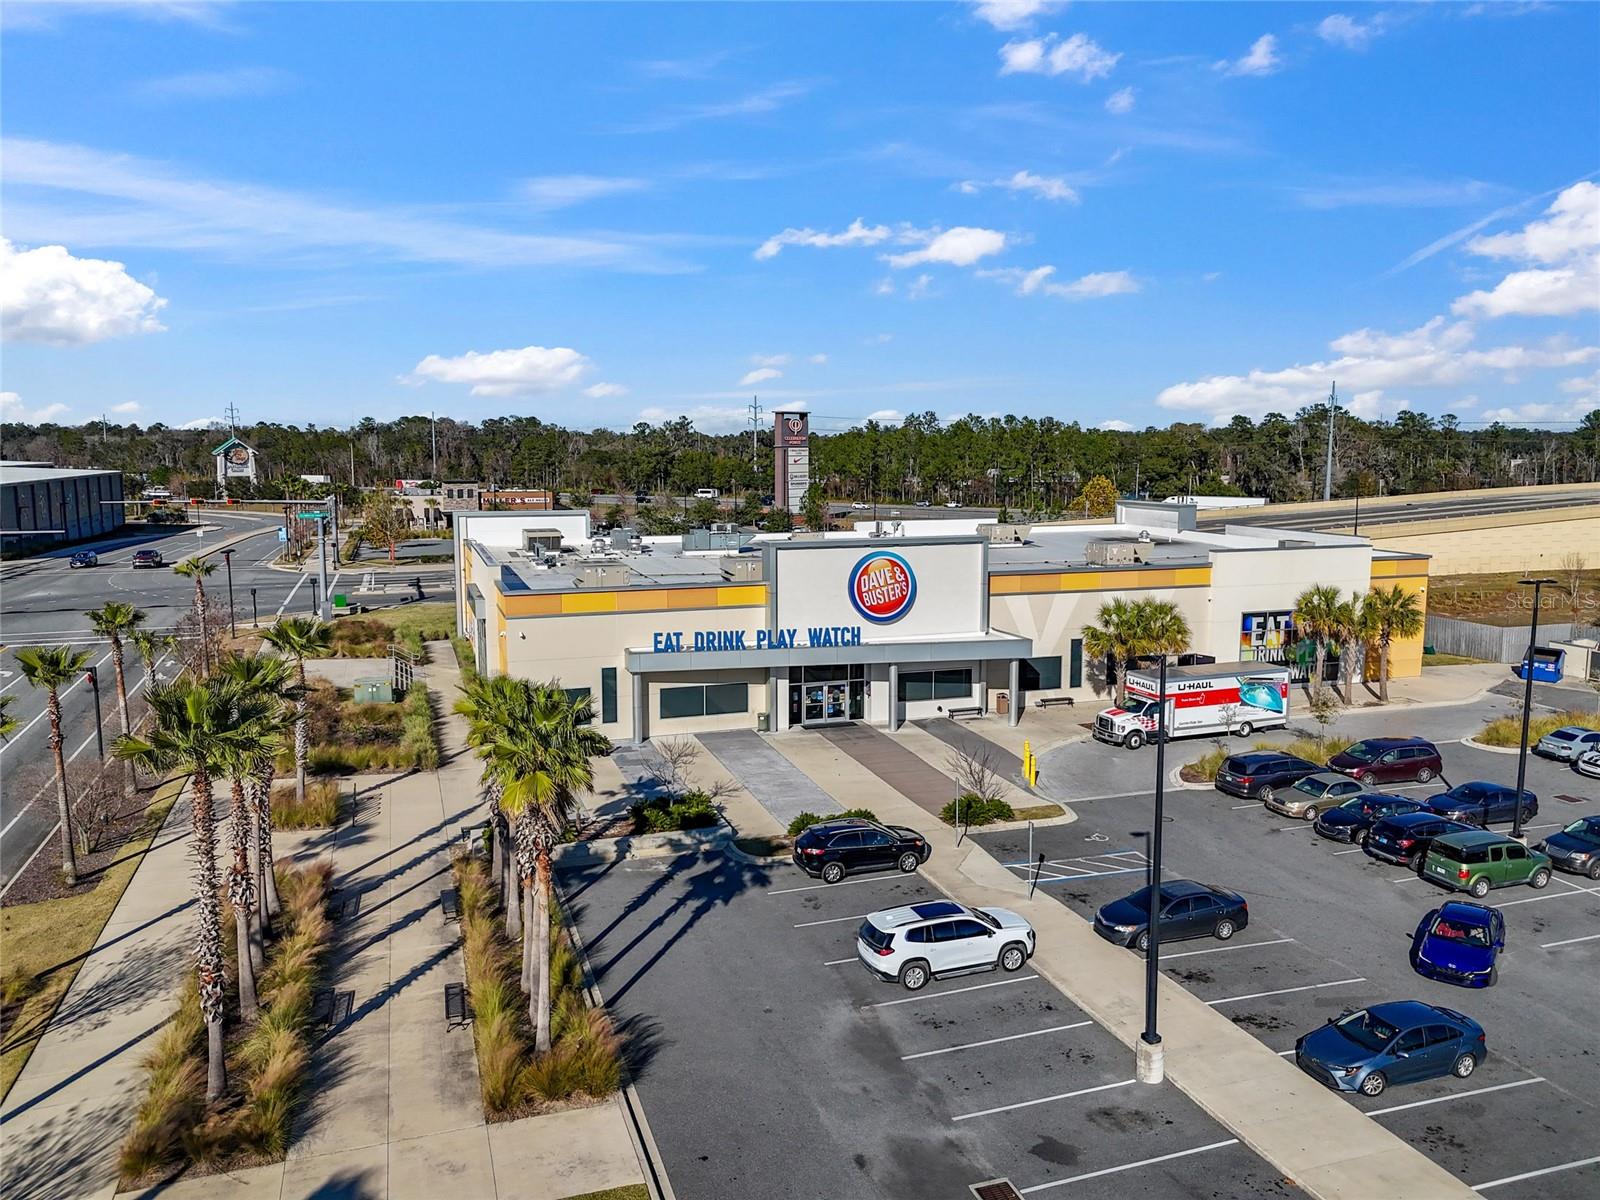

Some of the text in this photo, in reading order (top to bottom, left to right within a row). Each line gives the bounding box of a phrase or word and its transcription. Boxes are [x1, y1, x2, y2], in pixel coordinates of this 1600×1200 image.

[861, 566, 906, 592] DAVE &
[862, 581, 908, 607] BUSTER'S
[653, 627, 861, 653] EAT DRINK PLAY WATCH
[1250, 616, 1290, 648] EAT
[1178, 681, 1214, 691] U-HAUL
